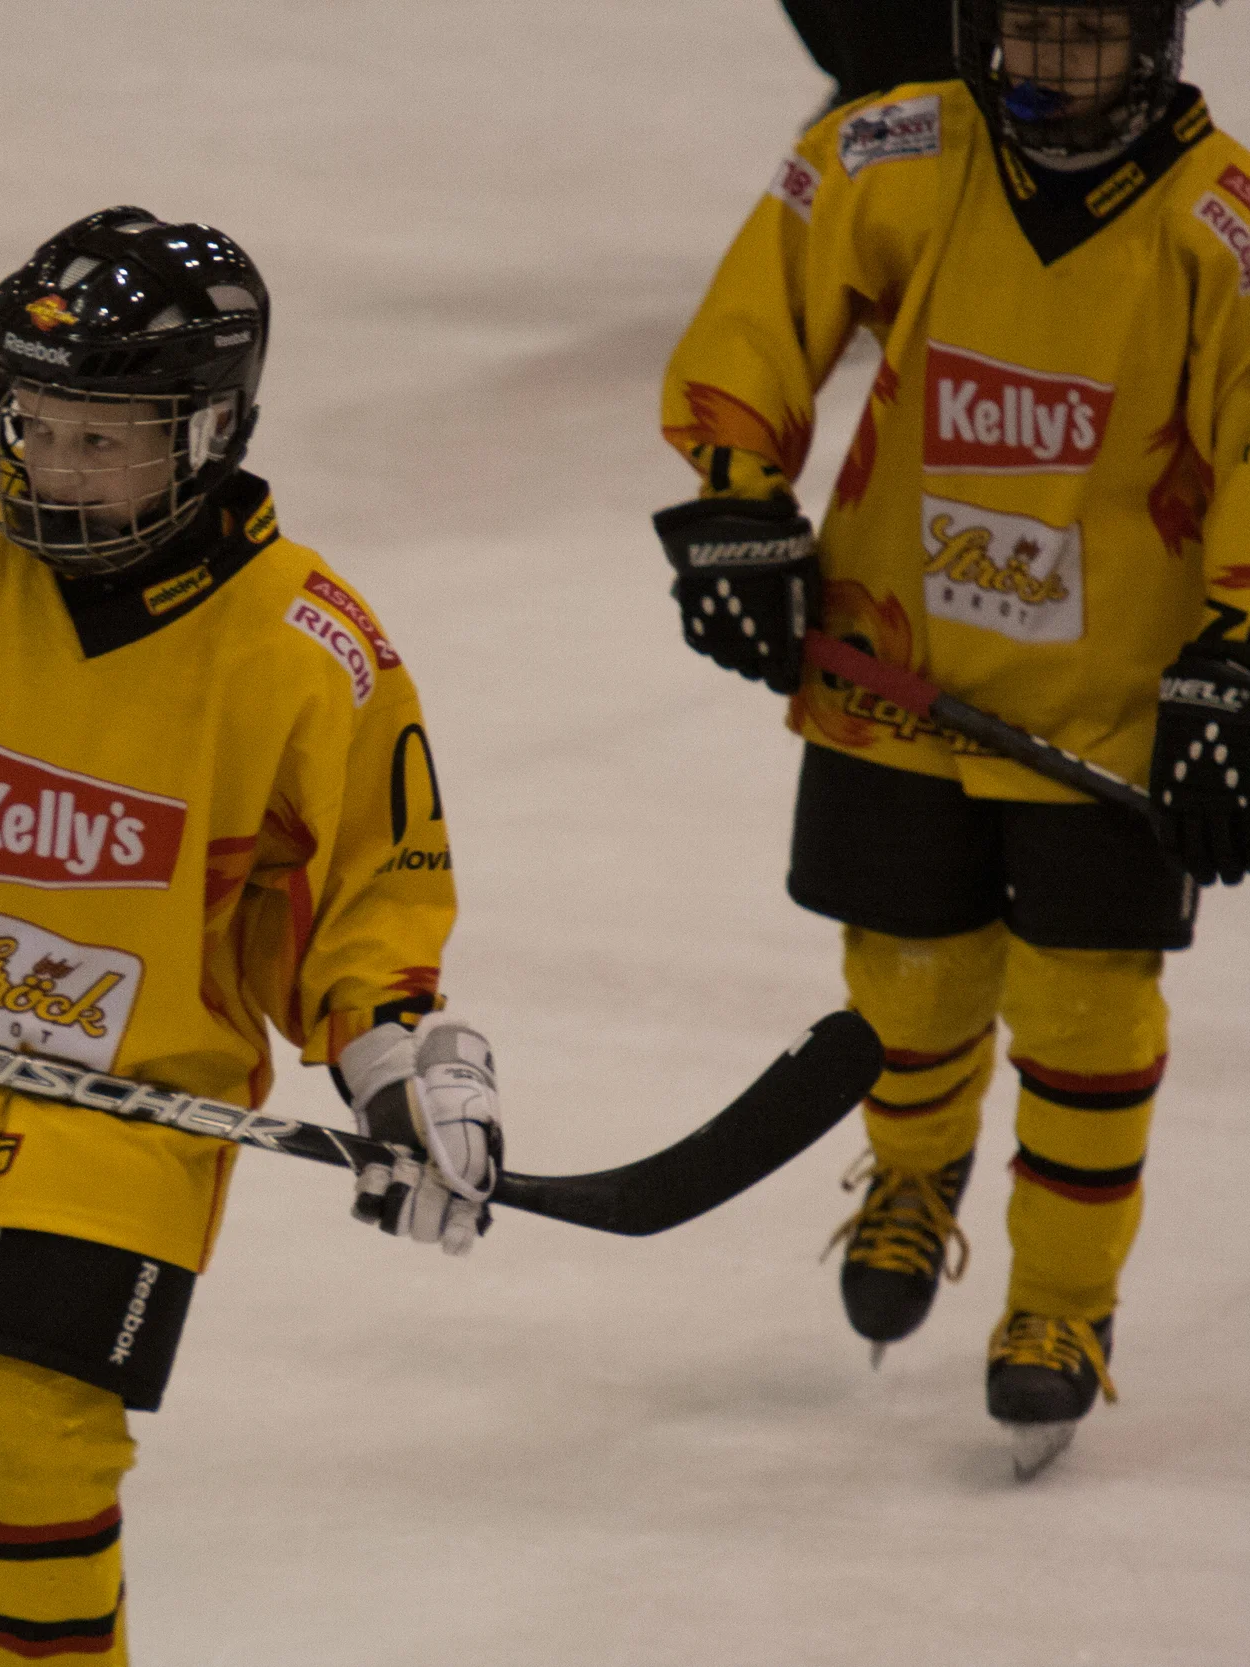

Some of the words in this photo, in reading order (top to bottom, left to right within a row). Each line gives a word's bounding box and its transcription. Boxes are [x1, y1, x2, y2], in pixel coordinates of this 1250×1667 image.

[3, 330, 74, 368] Reebok
[937, 377, 1097, 460] Kelly's
[312, 581, 376, 633] ASKO
[293, 604, 372, 699] RICOH
[108, 1260, 161, 1366] Reebok
